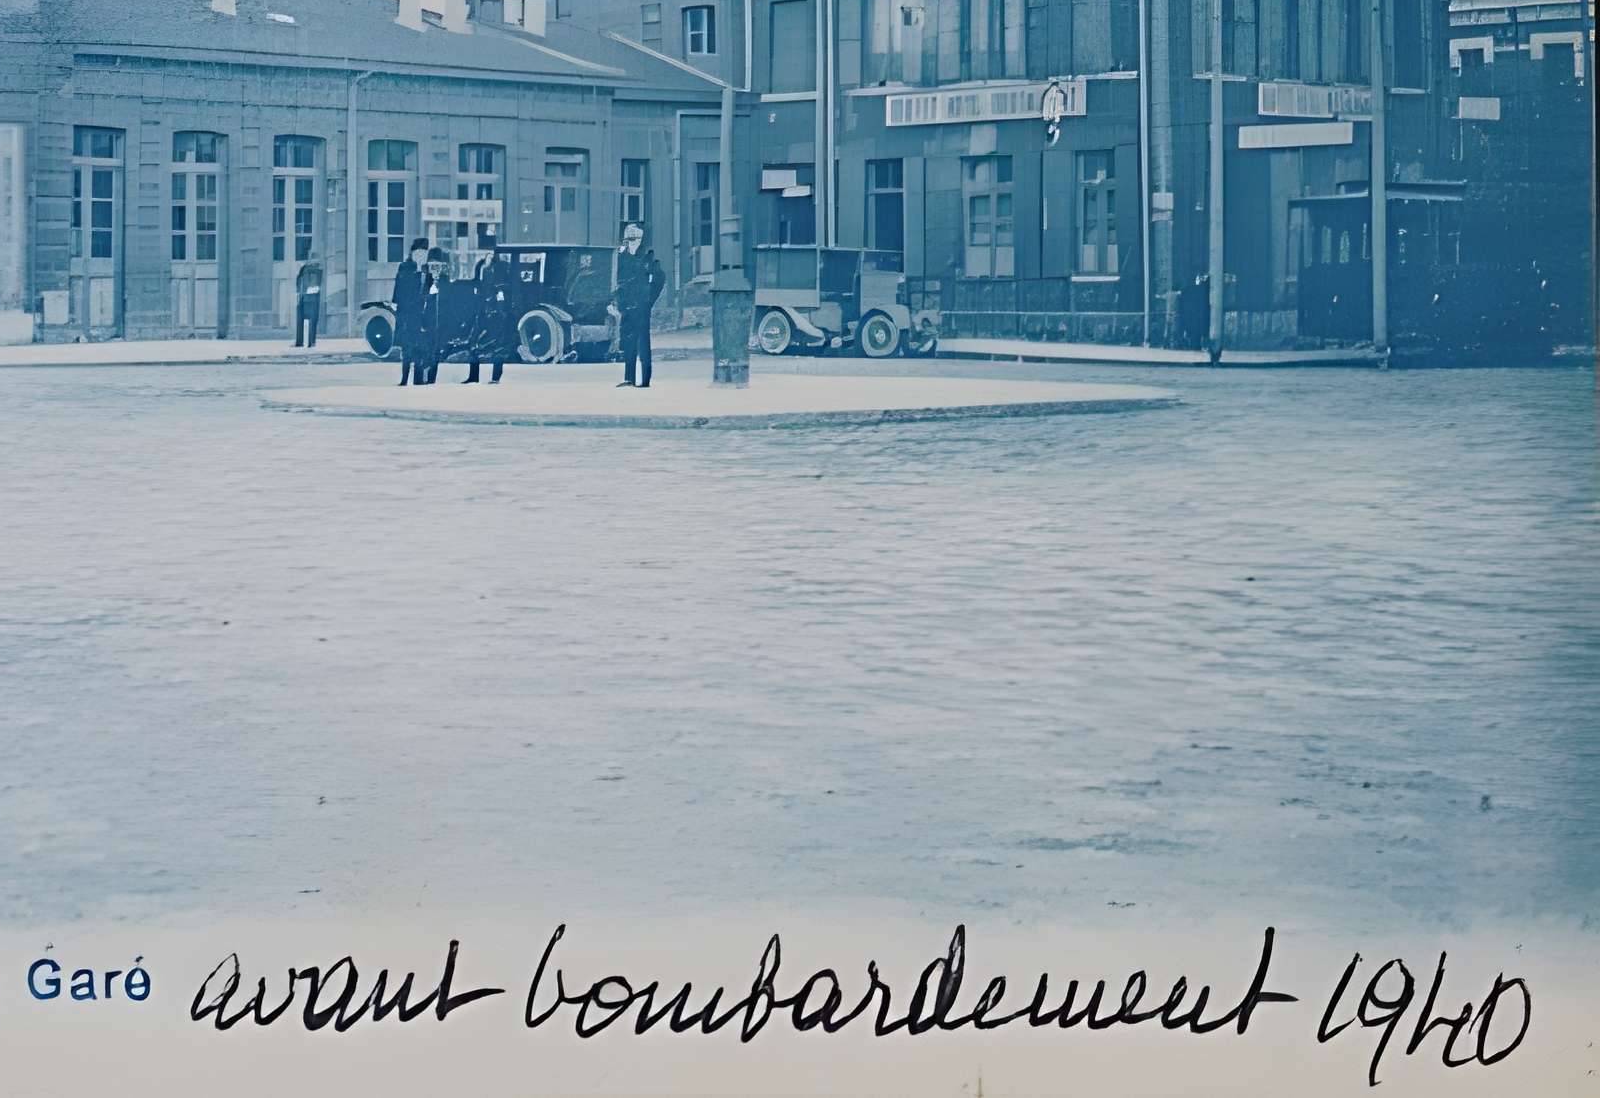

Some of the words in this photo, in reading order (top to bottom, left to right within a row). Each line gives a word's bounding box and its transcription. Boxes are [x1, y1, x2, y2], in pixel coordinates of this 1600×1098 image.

[191, 938, 505, 1033] avant
[524, 924, 1299, 1043] bombardement
[1317, 950, 1532, 1086] 1940
